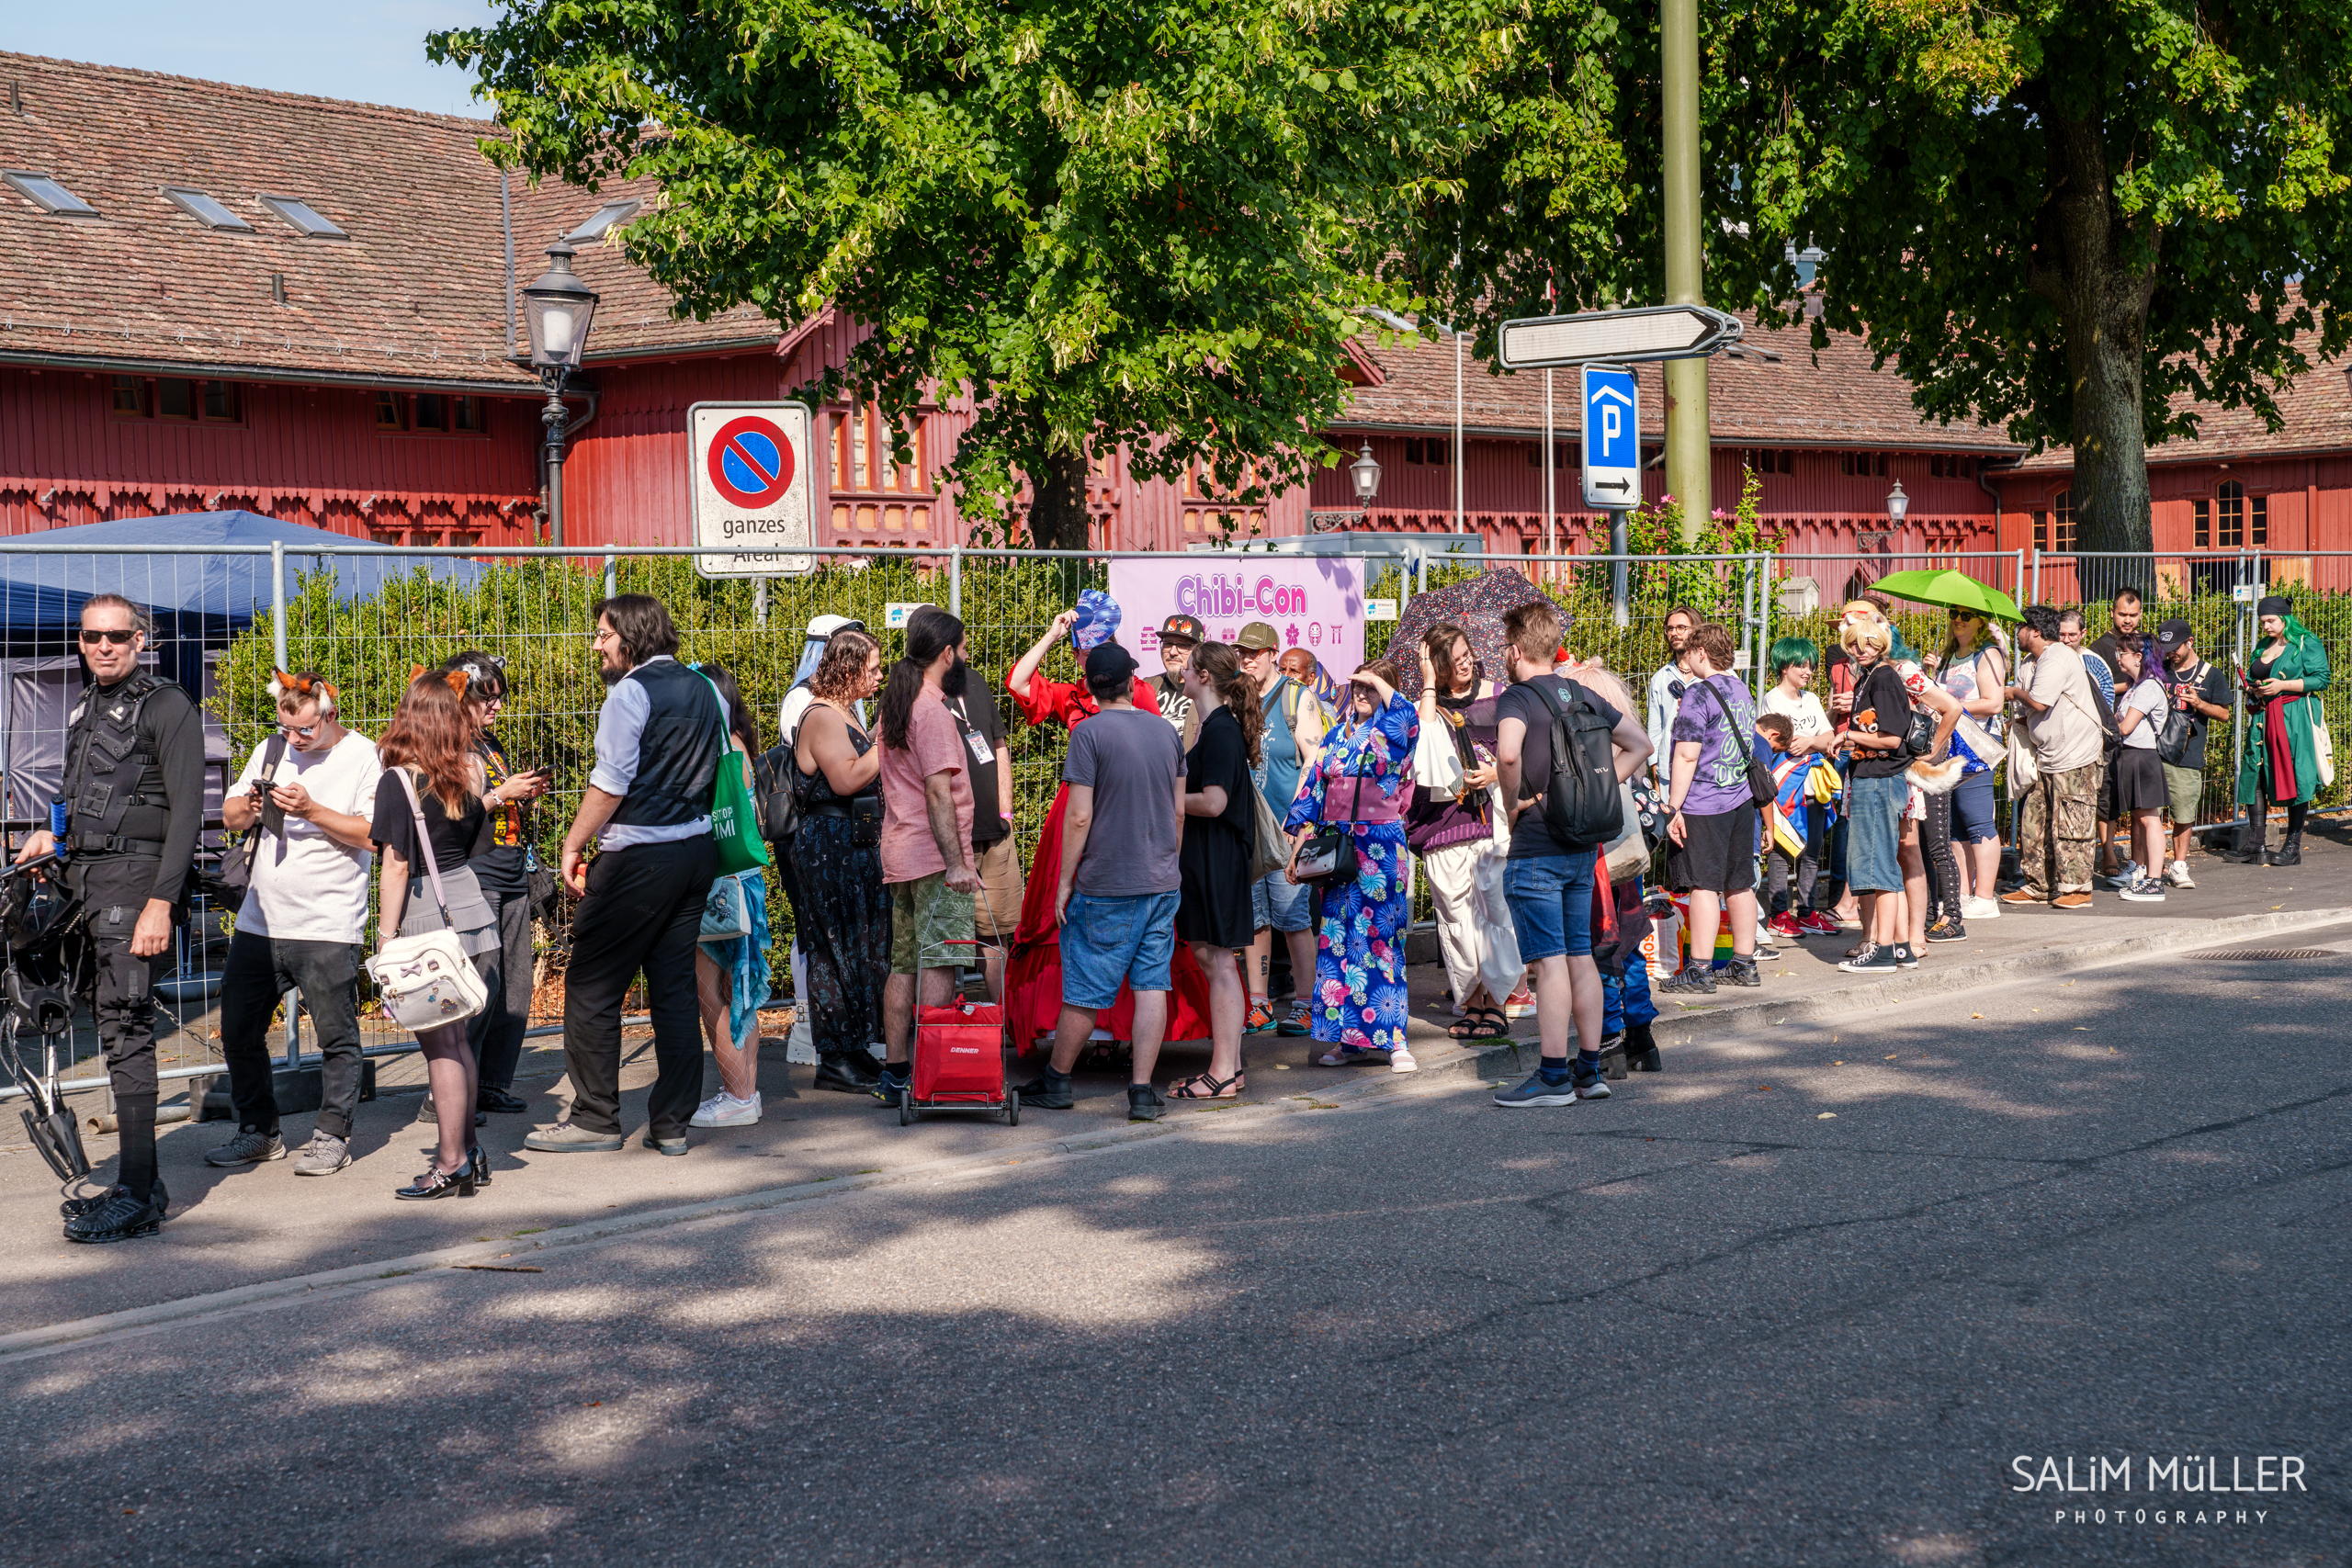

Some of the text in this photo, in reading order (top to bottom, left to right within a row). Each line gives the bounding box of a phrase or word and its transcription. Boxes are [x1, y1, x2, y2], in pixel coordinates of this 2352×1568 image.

[1602, 404, 1621, 457] P
[723, 519, 786, 538] ganzes
[1174, 573, 1307, 617] Chibi-Con
[712, 807, 733, 822] STOP
